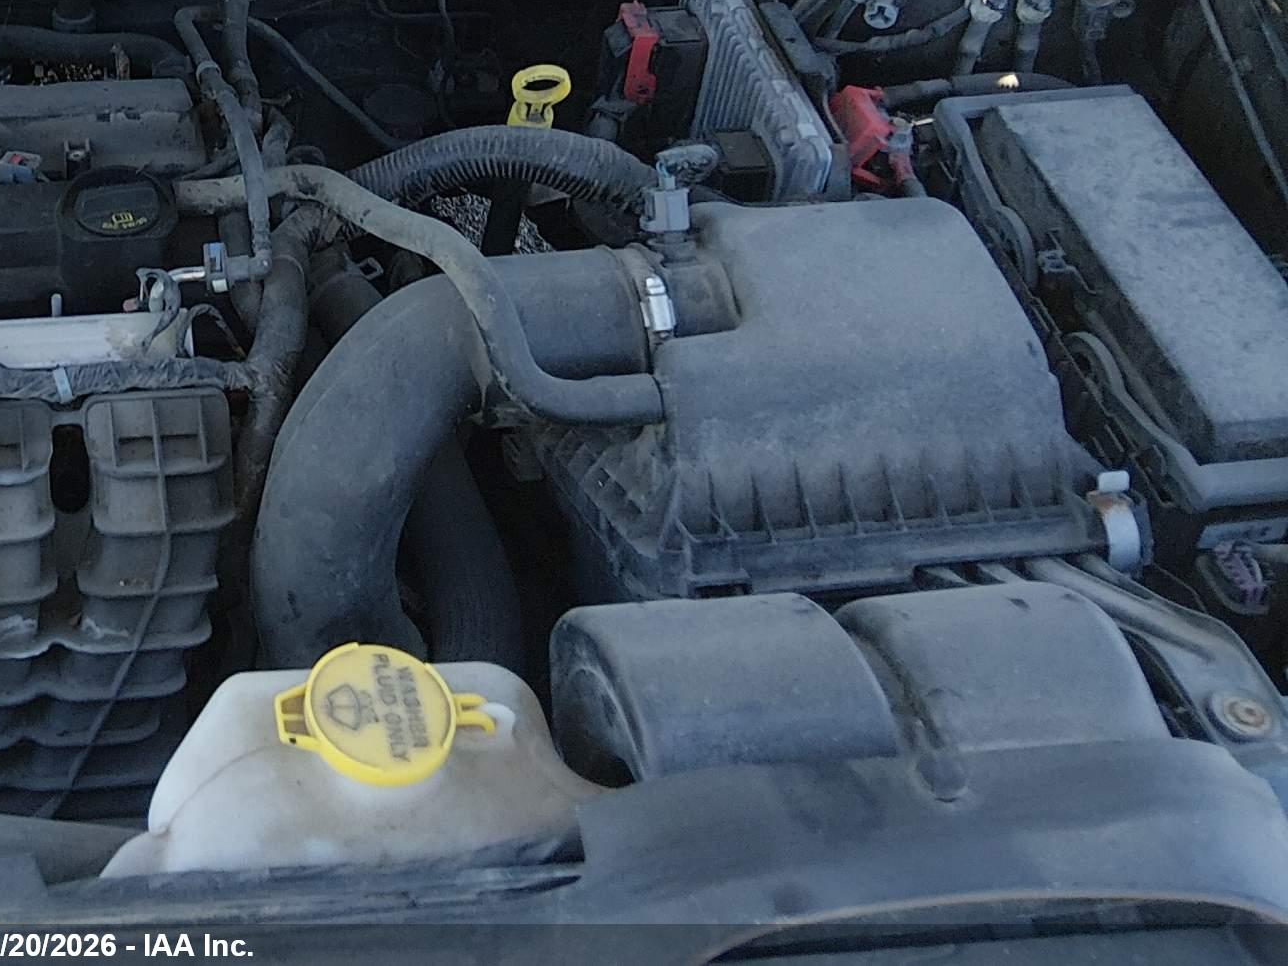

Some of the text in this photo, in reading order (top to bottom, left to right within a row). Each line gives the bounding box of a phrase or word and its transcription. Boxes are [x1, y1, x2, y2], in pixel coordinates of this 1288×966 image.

[373, 653, 411, 762] FLUID ONLY
[397, 665, 429, 748] WASHER
